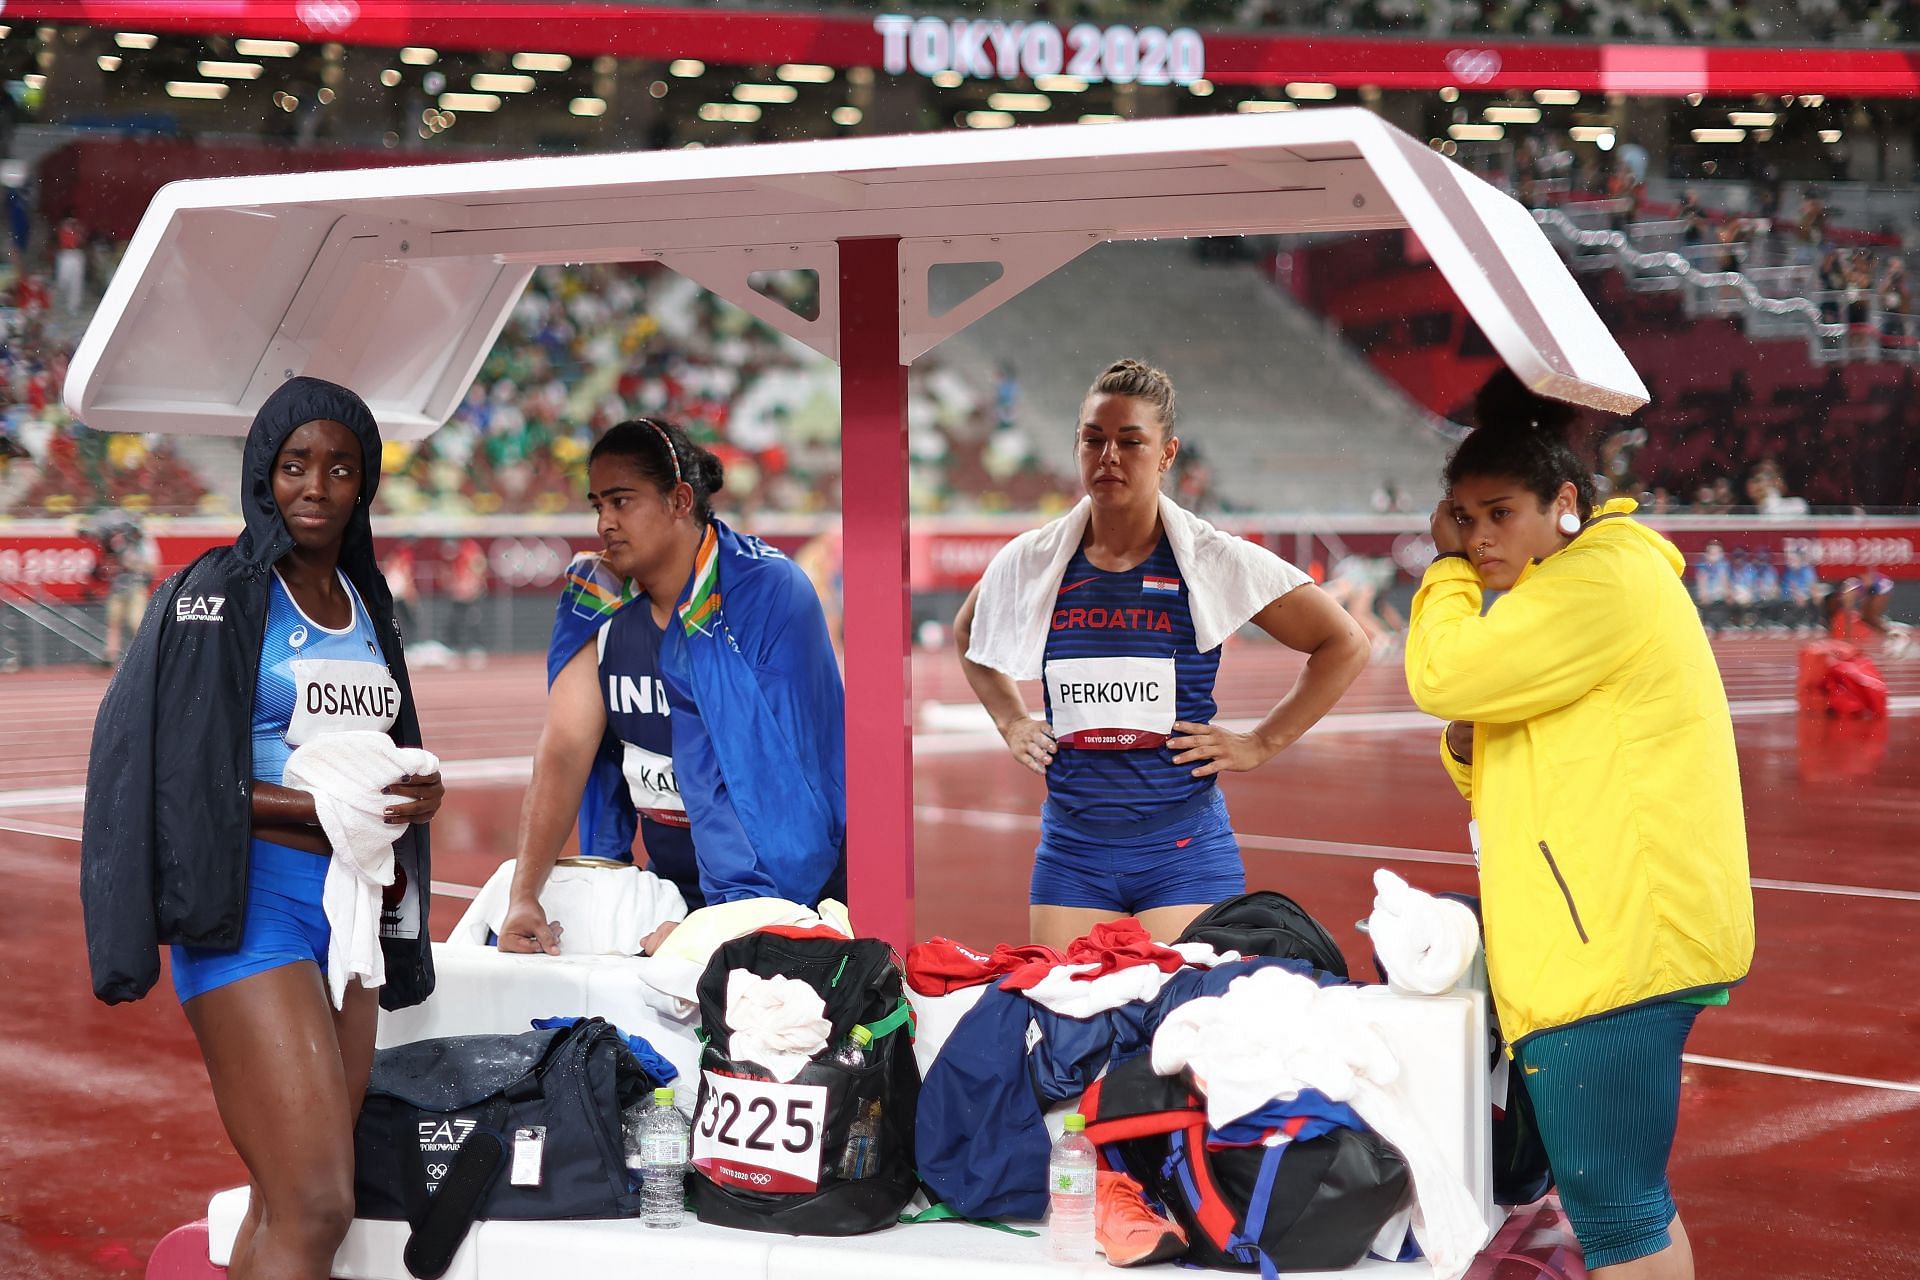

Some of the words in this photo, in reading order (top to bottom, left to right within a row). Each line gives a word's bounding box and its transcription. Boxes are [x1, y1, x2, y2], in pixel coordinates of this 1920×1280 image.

[873, 14, 1064, 80] TOKYO
[1066, 23, 1206, 86] 2020
[176, 596, 226, 615] EA7
[1052, 607, 1172, 633] CROATIA
[306, 681, 395, 718] OSAKUE
[1060, 681, 1160, 704] PERKOVIC
[1084, 735, 1102, 744] TOKYO
[1102, 735, 1116, 744] 2020
[418, 1118, 477, 1143] EA7
[700, 1085, 814, 1154] 3225
[719, 1165, 735, 1177] TOKYO
[734, 1170, 749, 1181] 2020
